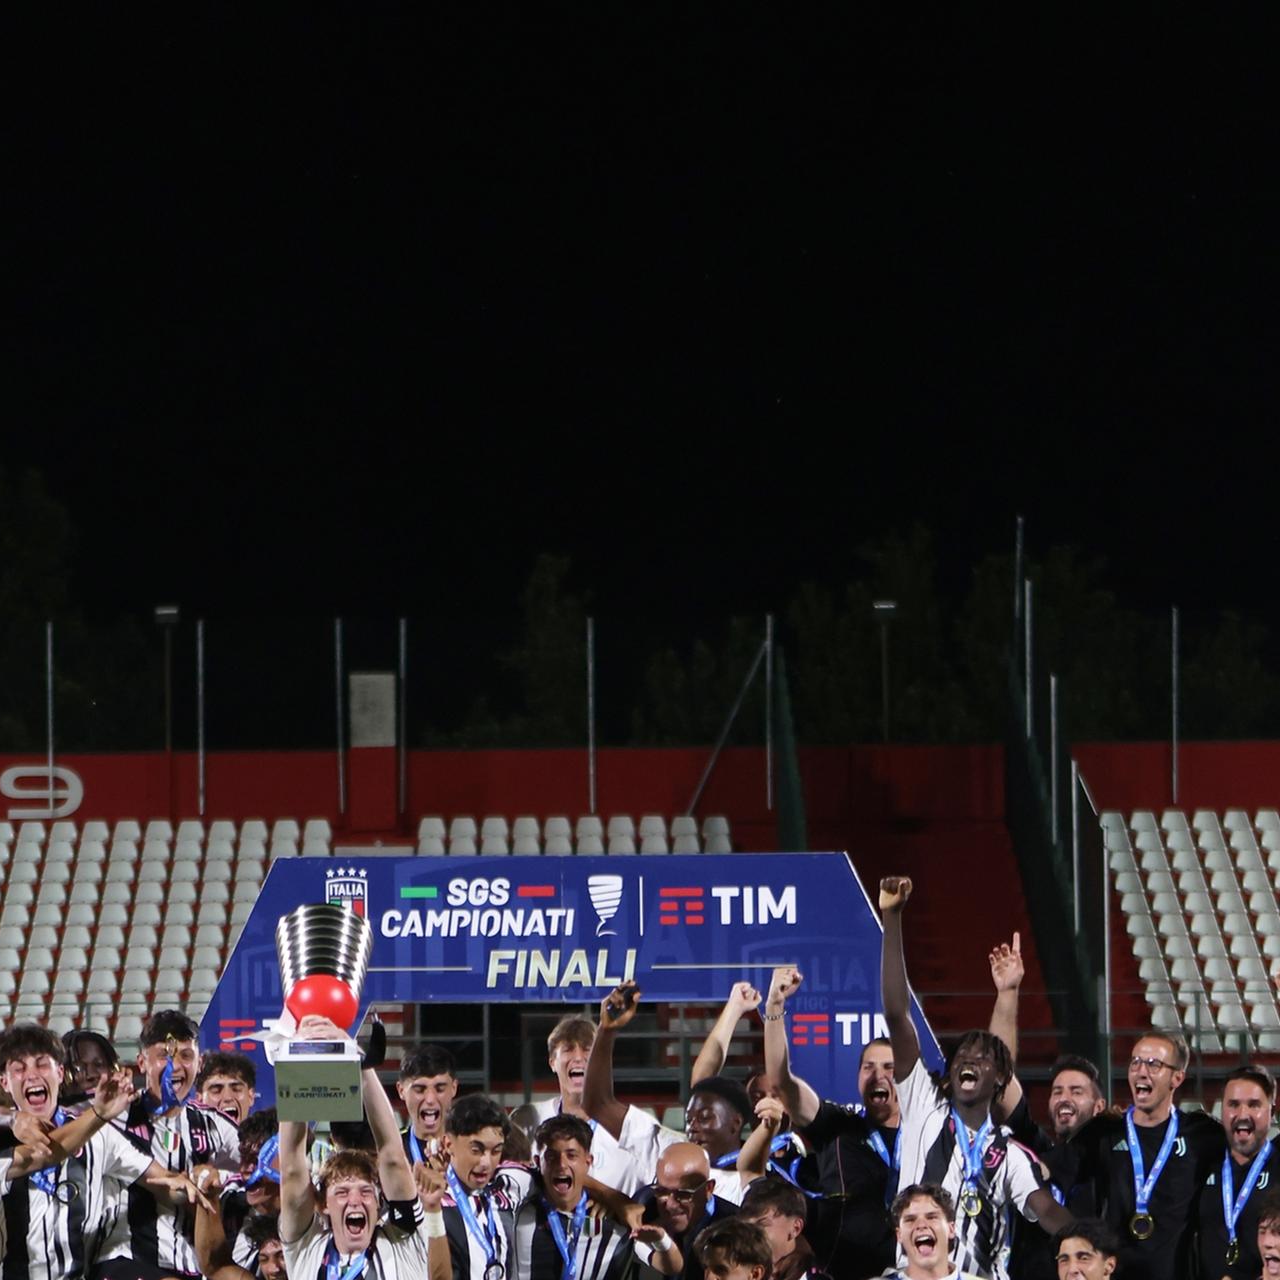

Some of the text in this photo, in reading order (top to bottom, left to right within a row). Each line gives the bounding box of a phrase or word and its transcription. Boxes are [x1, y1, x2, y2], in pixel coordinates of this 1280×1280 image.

[329, 883, 364, 896] ITALIA
[446, 877, 511, 906] SGS
[711, 886, 797, 925] TIM
[380, 908, 575, 938] CAMPIONATI
[486, 949, 637, 988] FINALI
